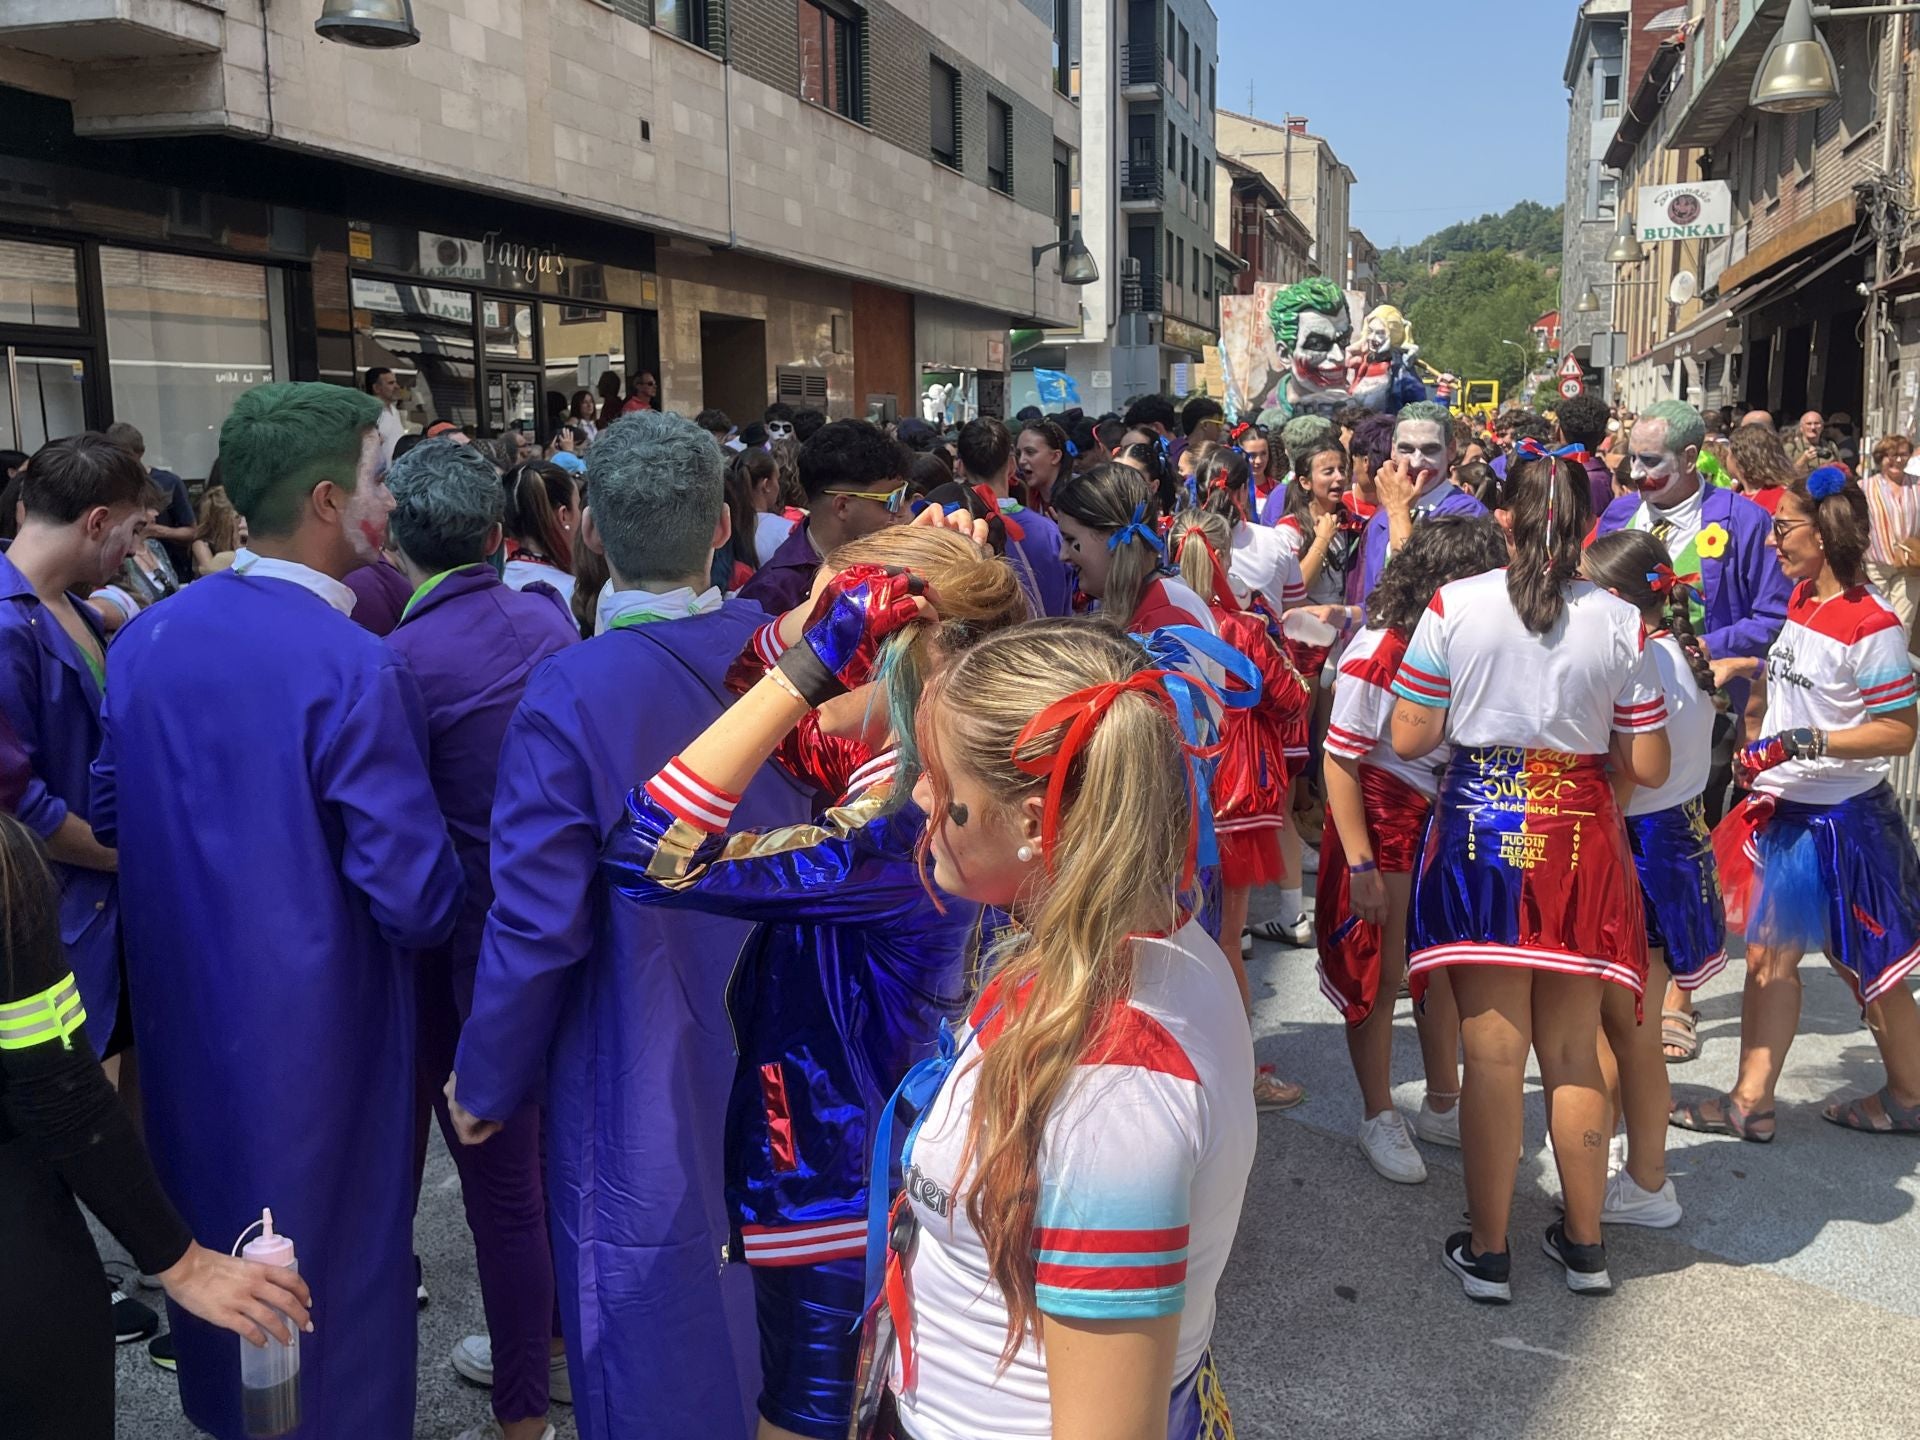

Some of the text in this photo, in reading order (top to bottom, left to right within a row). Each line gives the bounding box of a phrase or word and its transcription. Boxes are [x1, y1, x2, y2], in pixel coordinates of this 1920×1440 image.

[1643, 223, 1725, 240] BUNKAI
[482, 227, 565, 284] Tanga's
[1564, 384, 1578, 393] 30
[1492, 801, 1558, 816] established
[1502, 834, 1545, 848] PUDDIN
[1501, 845, 1544, 859] FREAKY
[905, 1163, 957, 1217] ter
